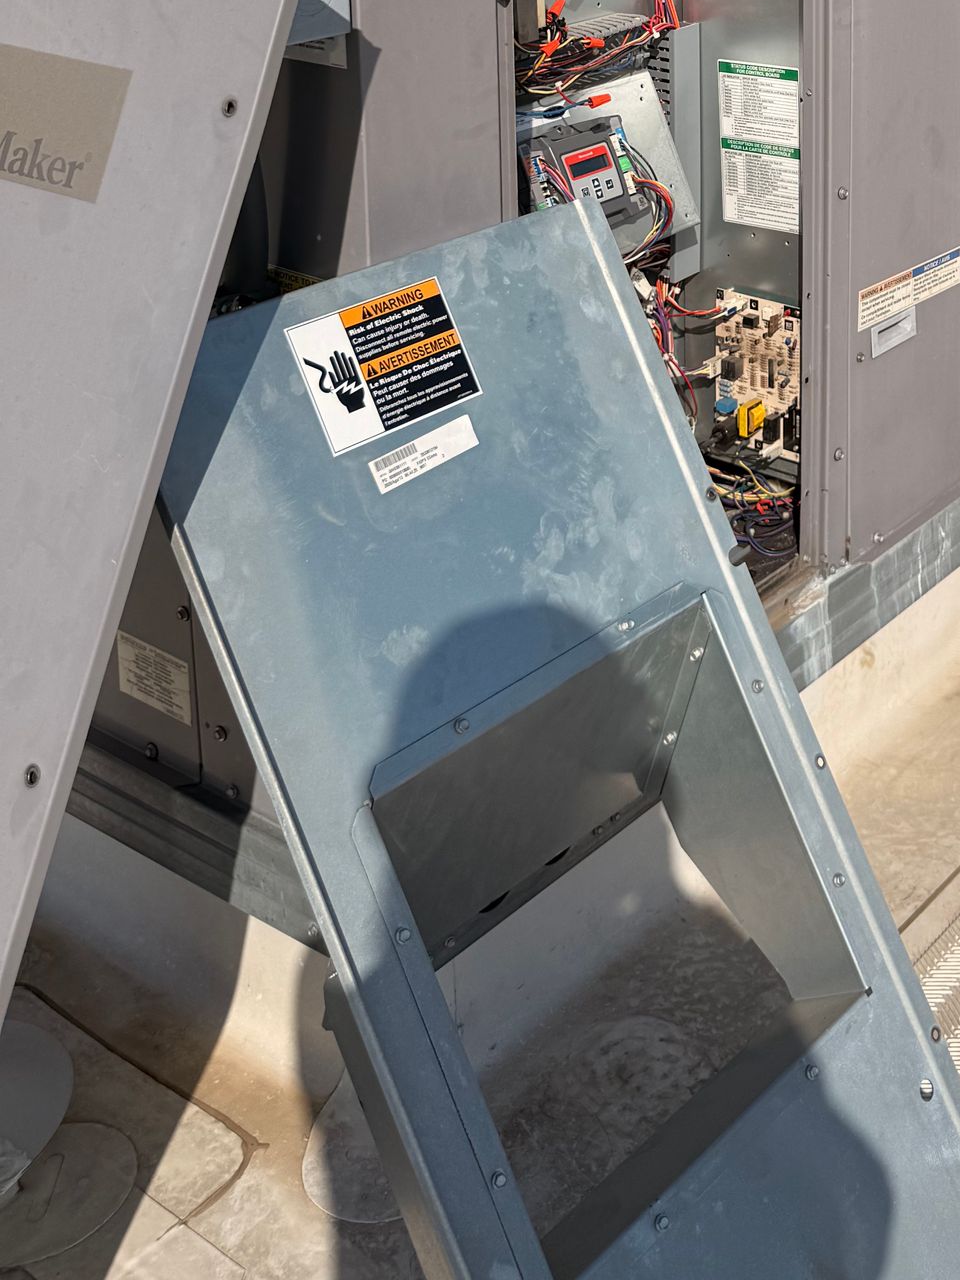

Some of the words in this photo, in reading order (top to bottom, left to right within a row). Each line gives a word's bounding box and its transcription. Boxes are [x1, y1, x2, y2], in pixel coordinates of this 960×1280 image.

[371, 289, 424, 315] WARNING
[348, 326, 365, 336] Risk
[374, 313, 402, 327] Electric
[402, 305, 424, 316] Shock
[352, 336, 366, 345] Can
[366, 329, 384, 340] cause
[385, 323, 402, 332] injury
[411, 313, 429, 323] death.
[355, 337, 386, 353] Disconnect
[394, 328, 412, 338] remote
[412, 321, 432, 331] electric
[432, 315, 447, 324] power
[358, 348, 382, 359] supplies
[382, 341, 399, 350] before
[399, 331, 424, 344] servicing.
[379, 333, 455, 373] AVERTISSEMENT
[373, 387, 388, 397] Peut
[388, 379, 409, 391] causer
[409, 374, 421, 382] des
[421, 361, 454, 378] dommages
[379, 373, 402, 385] Risque
[412, 362, 429, 372] Choc
[392, 388, 409, 398] mort.
